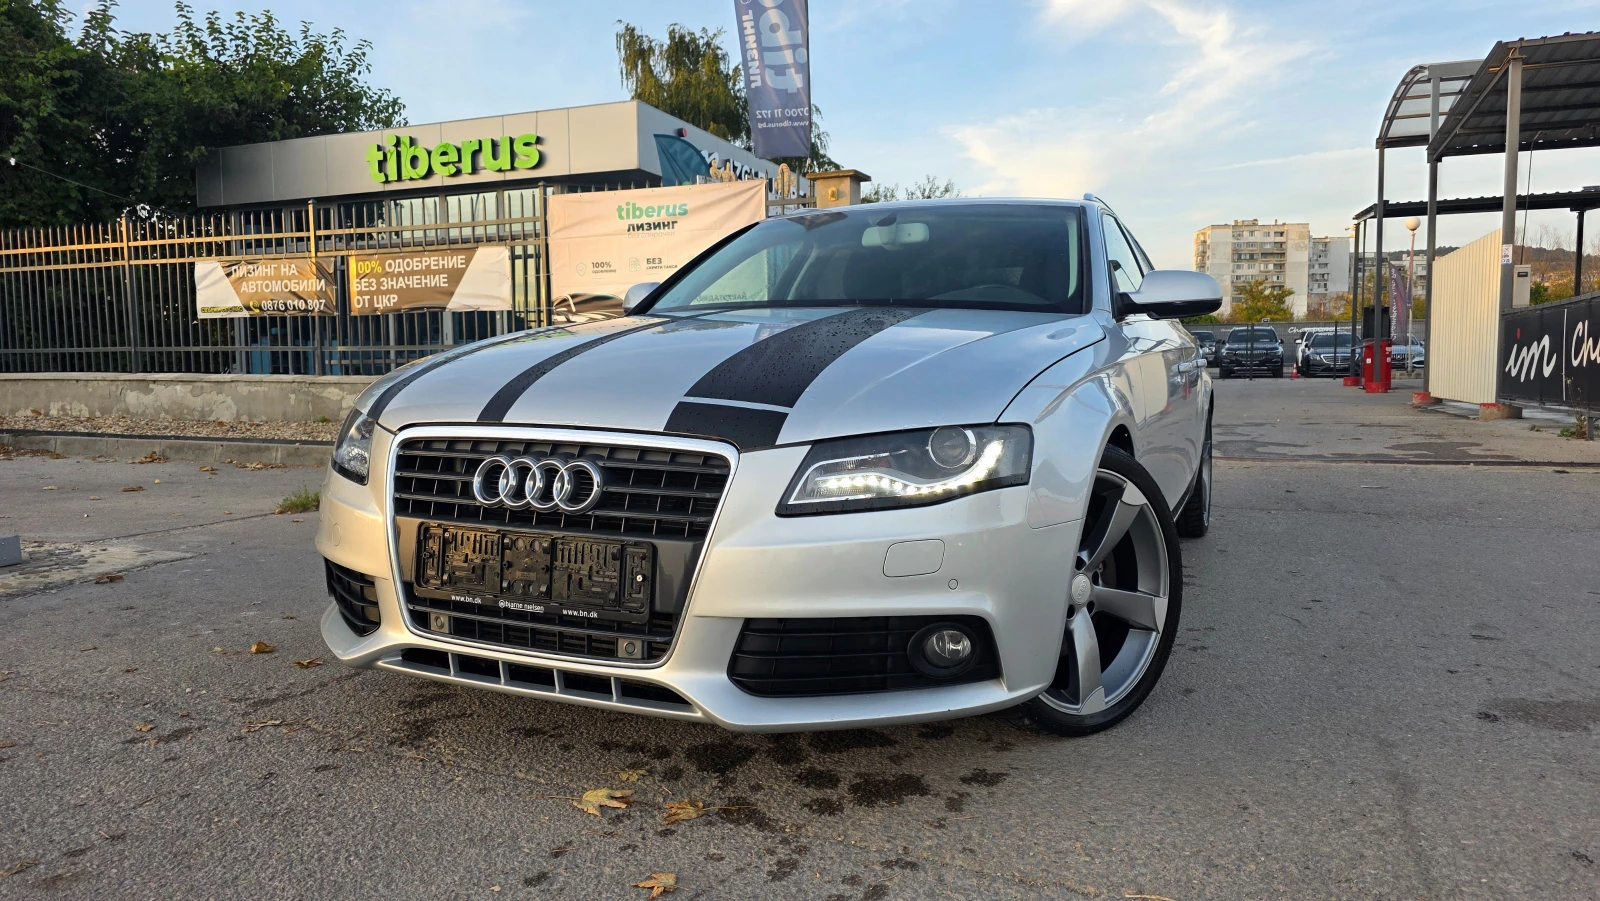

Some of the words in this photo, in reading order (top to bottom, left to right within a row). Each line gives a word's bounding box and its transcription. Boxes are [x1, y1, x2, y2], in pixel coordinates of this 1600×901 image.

[366, 133, 540, 183] tiberus
[616, 201, 689, 220] tiberus
[353, 260, 382, 274] 00%
[385, 255, 466, 274] ОДОБРЕНИЕ
[591, 261, 612, 269] 100%
[646, 257, 662, 265] БЕЗ
[231, 264, 278, 278] ЛИЗИНГ
[281, 263, 298, 276] НА
[240, 279, 326, 293] АВТОМОБИЛИ
[354, 278, 377, 291] БЕЗ
[380, 274, 449, 290] ЗНАЧЕНИЕ
[261, 300, 285, 311] 0876
[287, 299, 304, 310] 010
[307, 299, 326, 310] 807
[354, 295, 370, 308] ОТ
[373, 294, 398, 309] ЦКР
[451, 594, 482, 605] www.bn.dk
[562, 608, 598, 618] www.bn.dk
